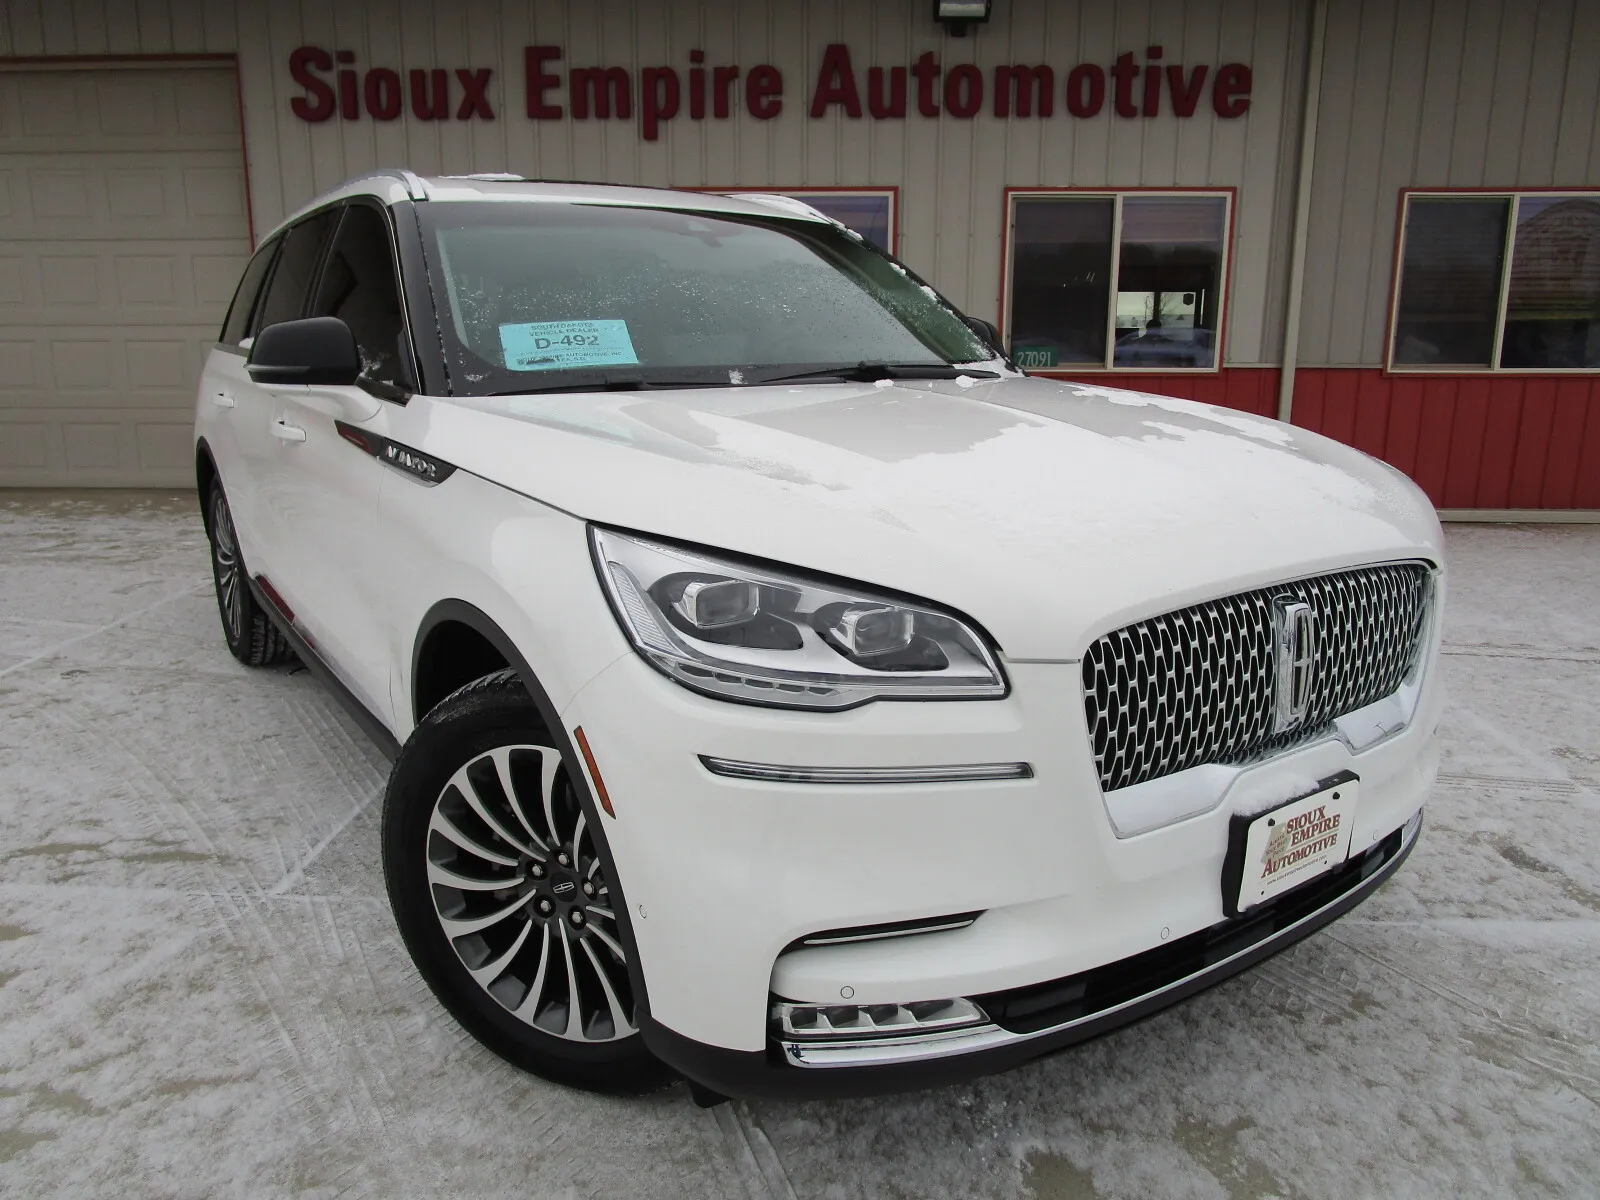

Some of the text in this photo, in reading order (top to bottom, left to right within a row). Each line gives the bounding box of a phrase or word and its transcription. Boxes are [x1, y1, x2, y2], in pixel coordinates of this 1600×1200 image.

[289, 44, 1253, 141] Sioux Empire Automotive
[534, 334, 600, 350] D-492
[1017, 351, 1051, 368] 27091
[1286, 805, 1327, 834] SIOUX
[1290, 813, 1341, 847] EMPIRE
[1260, 833, 1338, 879] AUTOMOTIVE
